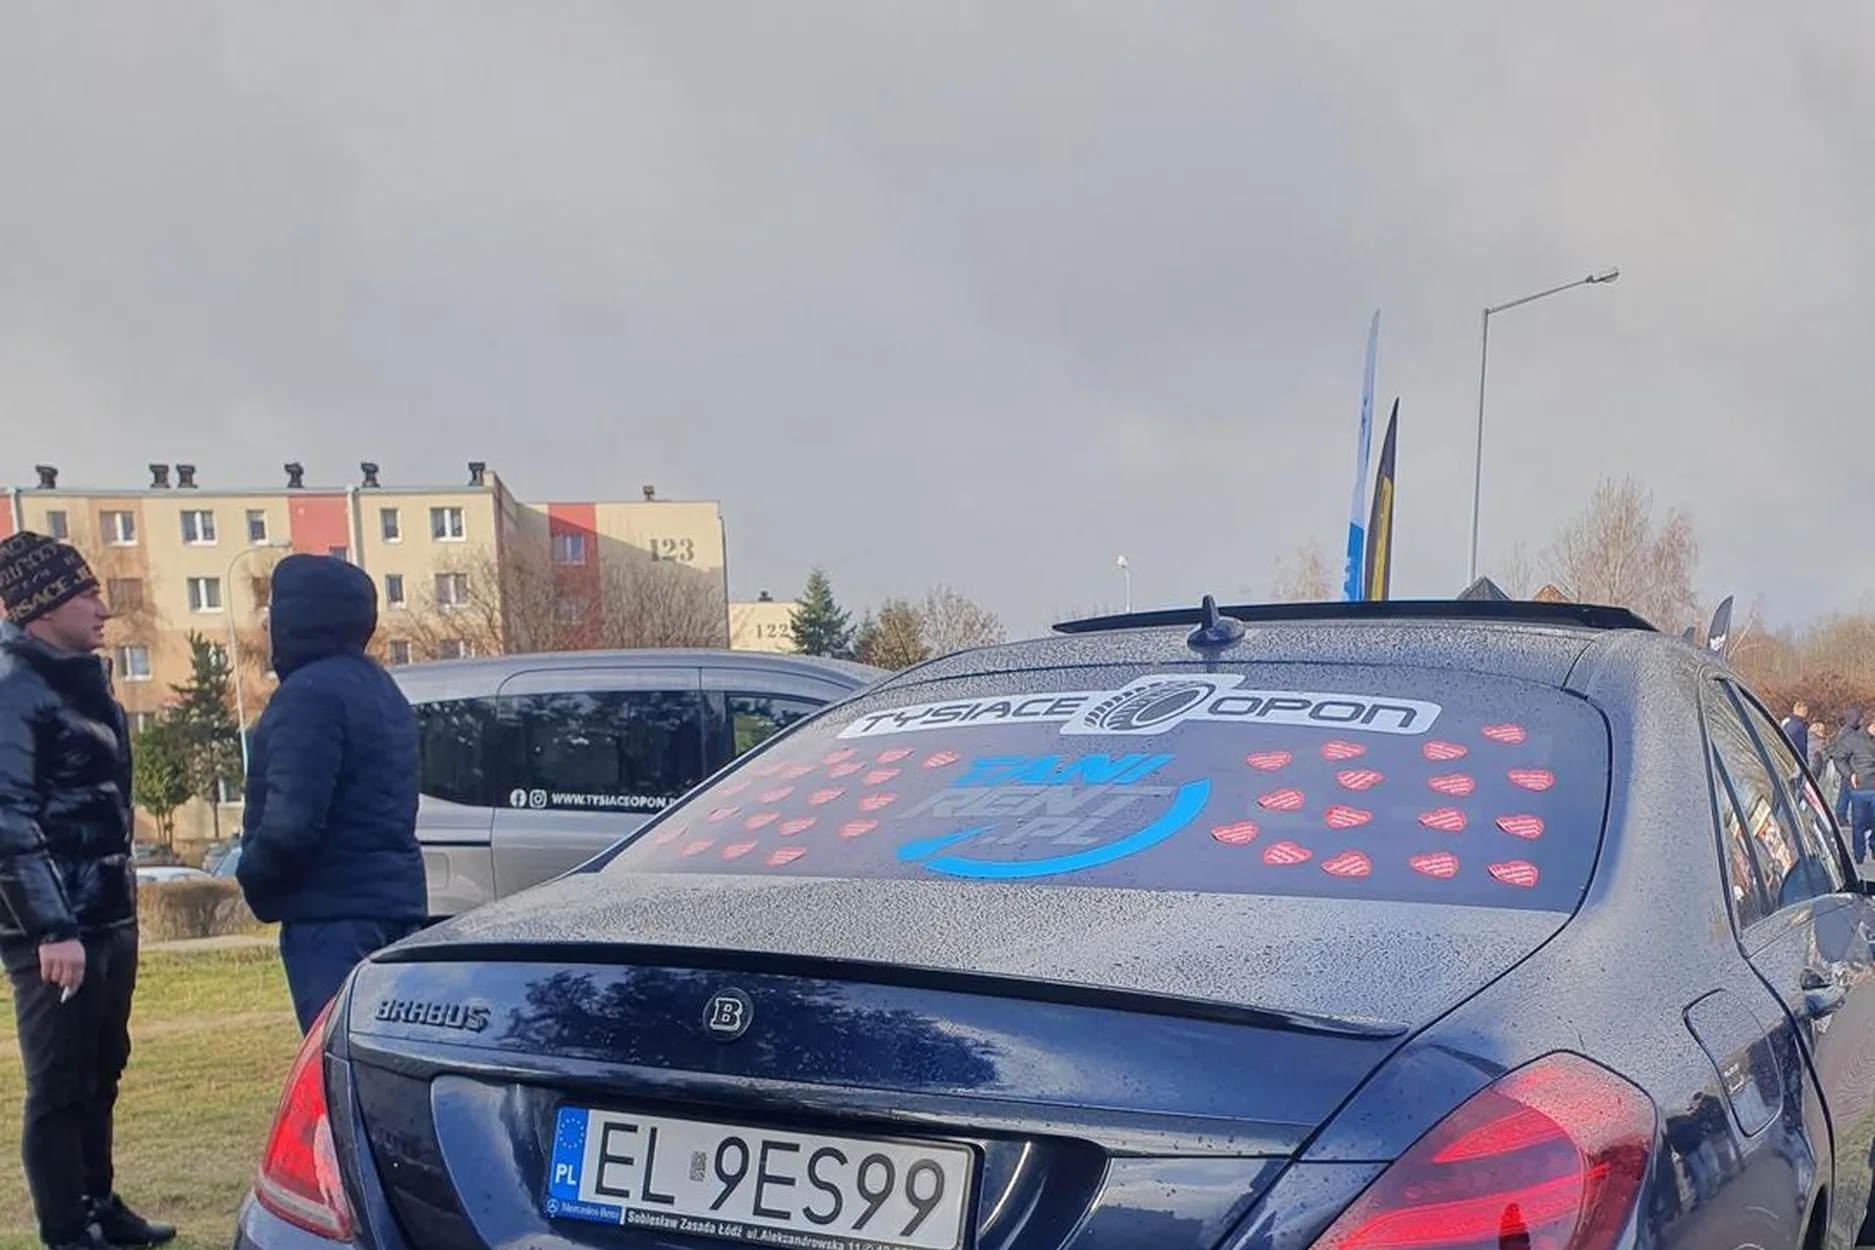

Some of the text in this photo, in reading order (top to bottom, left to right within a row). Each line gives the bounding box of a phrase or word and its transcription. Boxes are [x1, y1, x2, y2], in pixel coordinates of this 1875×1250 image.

[650, 538, 695, 562] 123
[756, 622, 791, 639] 122
[861, 696, 1418, 734] TYSIACE OPON
[900, 785, 1176, 818] RENT
[376, 999, 491, 1032] BRABUS
[555, 1164, 577, 1186] PL
[595, 1121, 946, 1238] EL 9ES99
[680, 1218, 716, 1234] Zasada
